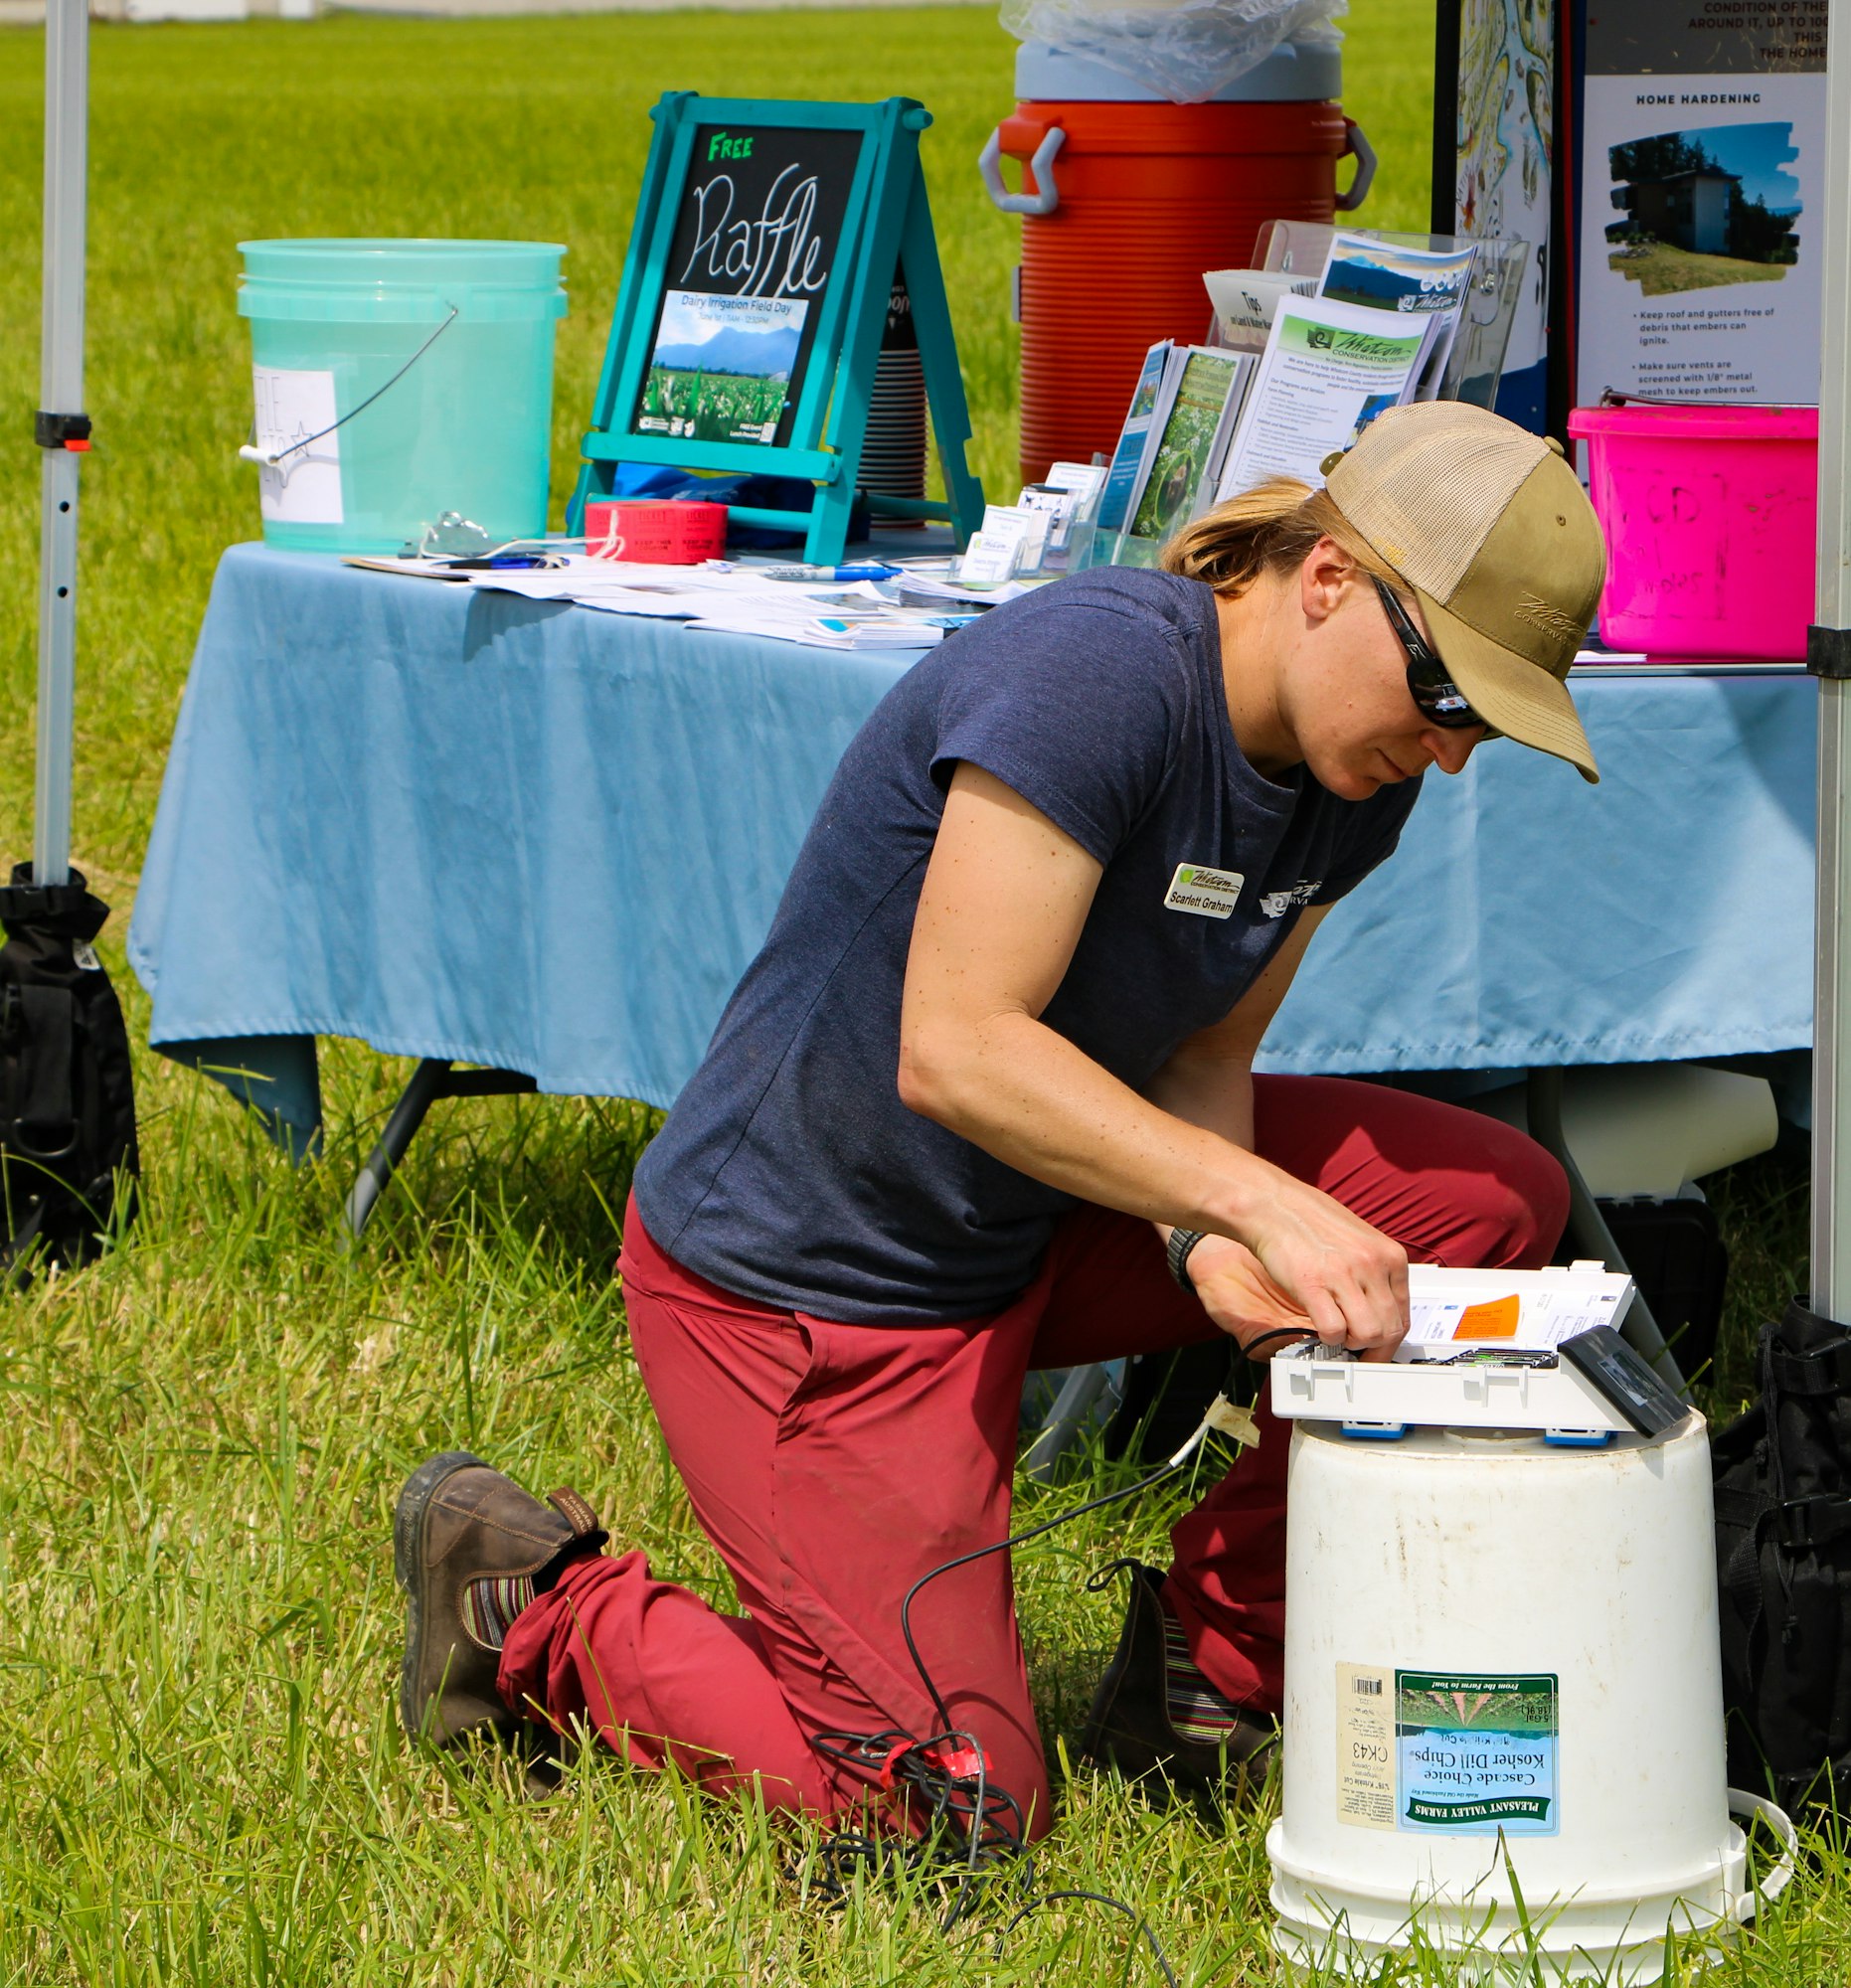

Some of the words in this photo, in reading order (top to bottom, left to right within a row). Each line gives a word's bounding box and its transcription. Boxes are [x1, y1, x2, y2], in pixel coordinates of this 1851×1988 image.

[1704, 1, 1776, 13] CONDITION
[1780, 1, 1797, 13] OF
[1803, 1, 1826, 12] THE
[1688, 18, 1744, 29] AROUND
[1767, 17, 1784, 28] UP
[1790, 17, 1806, 27] TO
[1794, 32, 1822, 43] THIS
[1760, 48, 1784, 59] THE
[1789, 48, 1827, 58] HOME
[1636, 94, 1675, 104] HOME
[1681, 93, 1762, 104] HARDENING
[708, 131, 754, 162] FREE
[681, 163, 827, 297] Raffle
[681, 294, 705, 308] Dairy
[708, 295, 749, 311] Irrigation
[751, 300, 772, 312] Field
[773, 302, 792, 315] Day
[1241, 291, 1262, 316] Tips
[1640, 311, 1663, 320] Keep
[1708, 309, 1741, 319] gutters
[1744, 308, 1763, 317] free
[1640, 323, 1668, 332] debris
[1693, 322, 1728, 331] embers
[1337, 331, 1412, 356] Whatcom
[1639, 336, 1670, 346] ignite.
[1332, 349, 1388, 363] CONSERVATION
[1639, 362, 1664, 371] Make
[1638, 375, 1681, 384] screened
[1684, 374, 1704, 383] with
[1726, 372, 1753, 381] metal
[1638, 387, 1663, 396] mesh
[1678, 387, 1702, 397] keep
[1704, 386, 1738, 395] embers
[1192, 869, 1241, 891] Whatcom
[1190, 882, 1221, 893] CONSERVATION
[1170, 892, 1202, 908] Scarlett
[1202, 897, 1233, 913] Graham
[1431, 1681, 1449, 1690] You!
[1353, 1742, 1388, 1763] CK43
[1415, 1746, 1456, 1767] Chips
[1460, 1753, 1488, 1768] Dill
[1493, 1753, 1545, 1768] Kosher
[1343, 1776, 1353, 1785] Cut
[1424, 1770, 1472, 1786] Choice
[1477, 1772, 1536, 1786] Cascade
[1415, 1804, 1447, 1818] FARMS
[1450, 1805, 1487, 1818] VALLEY
[1490, 1801, 1539, 1813] PLEASANT
